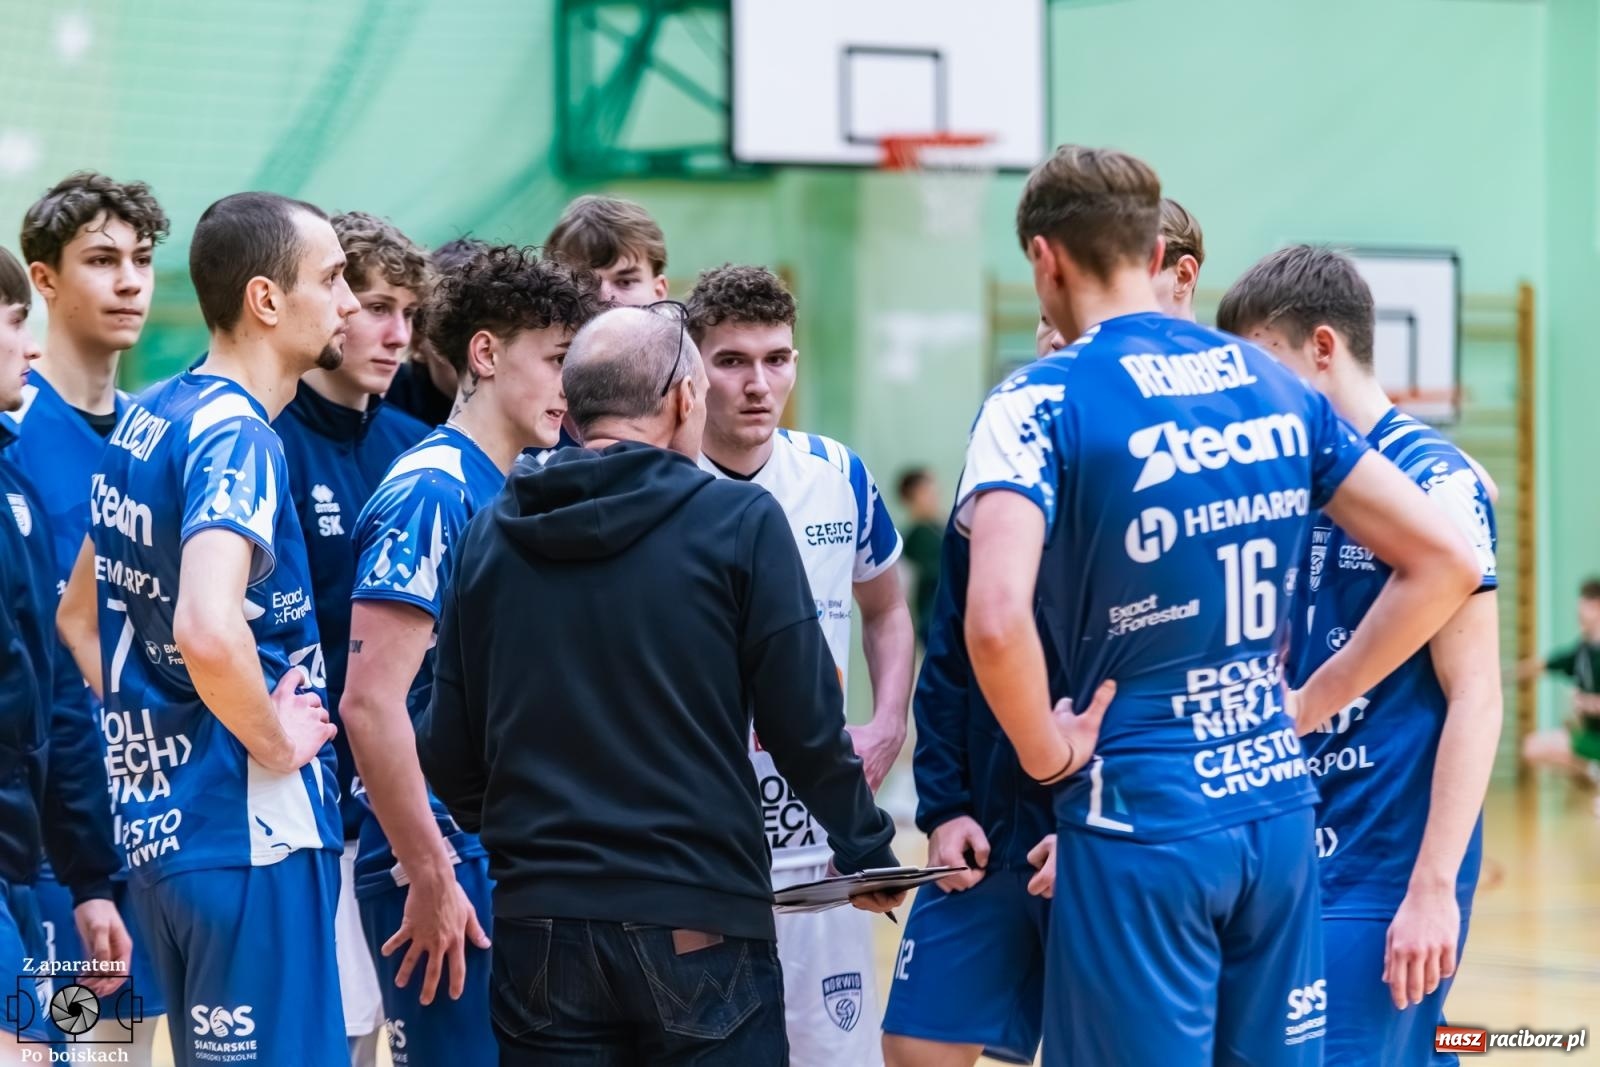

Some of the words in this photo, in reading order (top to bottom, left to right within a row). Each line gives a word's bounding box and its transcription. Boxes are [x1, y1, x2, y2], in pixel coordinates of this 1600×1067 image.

[1119, 344, 1258, 398] REMBISZ
[318, 515, 345, 537] SK
[273, 586, 303, 609] Exact
[1109, 594, 1158, 624] Exact
[1217, 537, 1278, 647] 16
[107, 598, 135, 692] 7
[101, 707, 155, 745] OLI
[895, 938, 916, 981] 12
[194, 1039, 258, 1052] SIATKARSKIE
